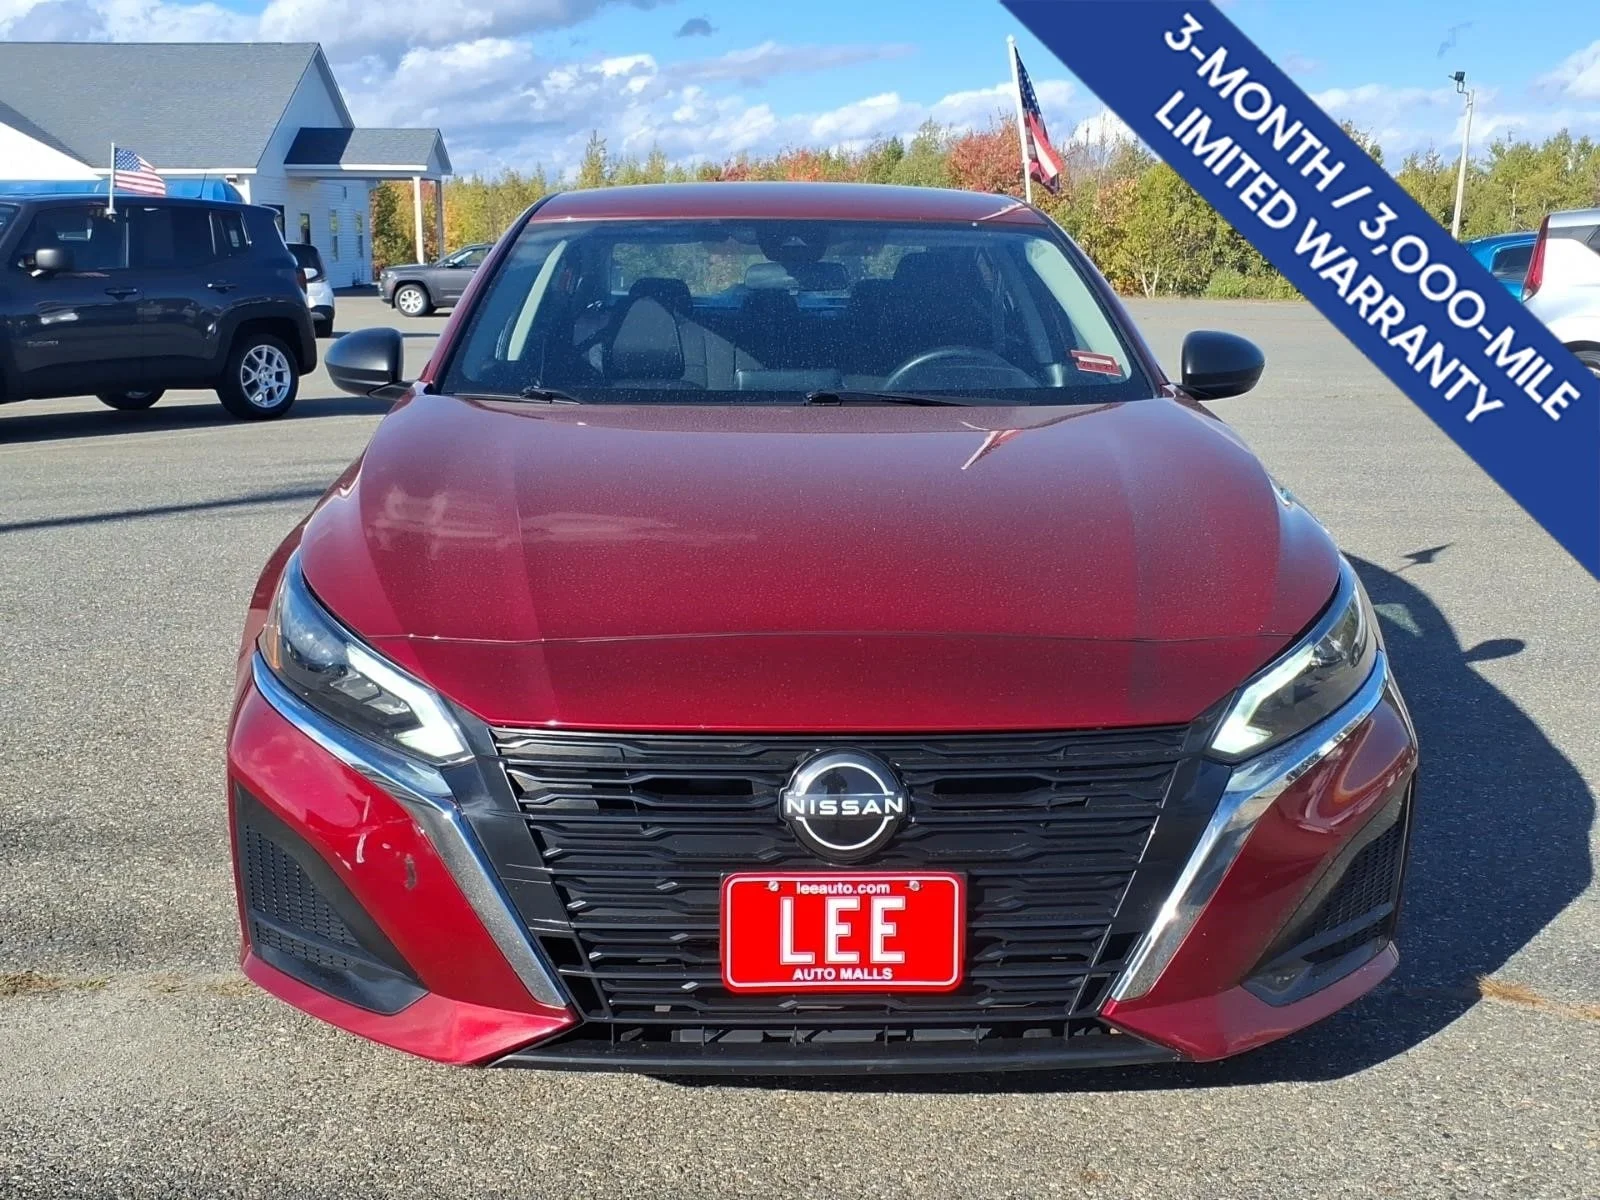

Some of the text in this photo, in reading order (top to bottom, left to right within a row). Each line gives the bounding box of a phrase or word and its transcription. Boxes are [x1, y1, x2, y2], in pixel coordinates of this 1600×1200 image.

[786, 798, 903, 815] NISSAN
[796, 881, 890, 895] leeauto.com
[779, 896, 906, 966] LEE
[792, 967, 893, 981] AUTO MALLS
